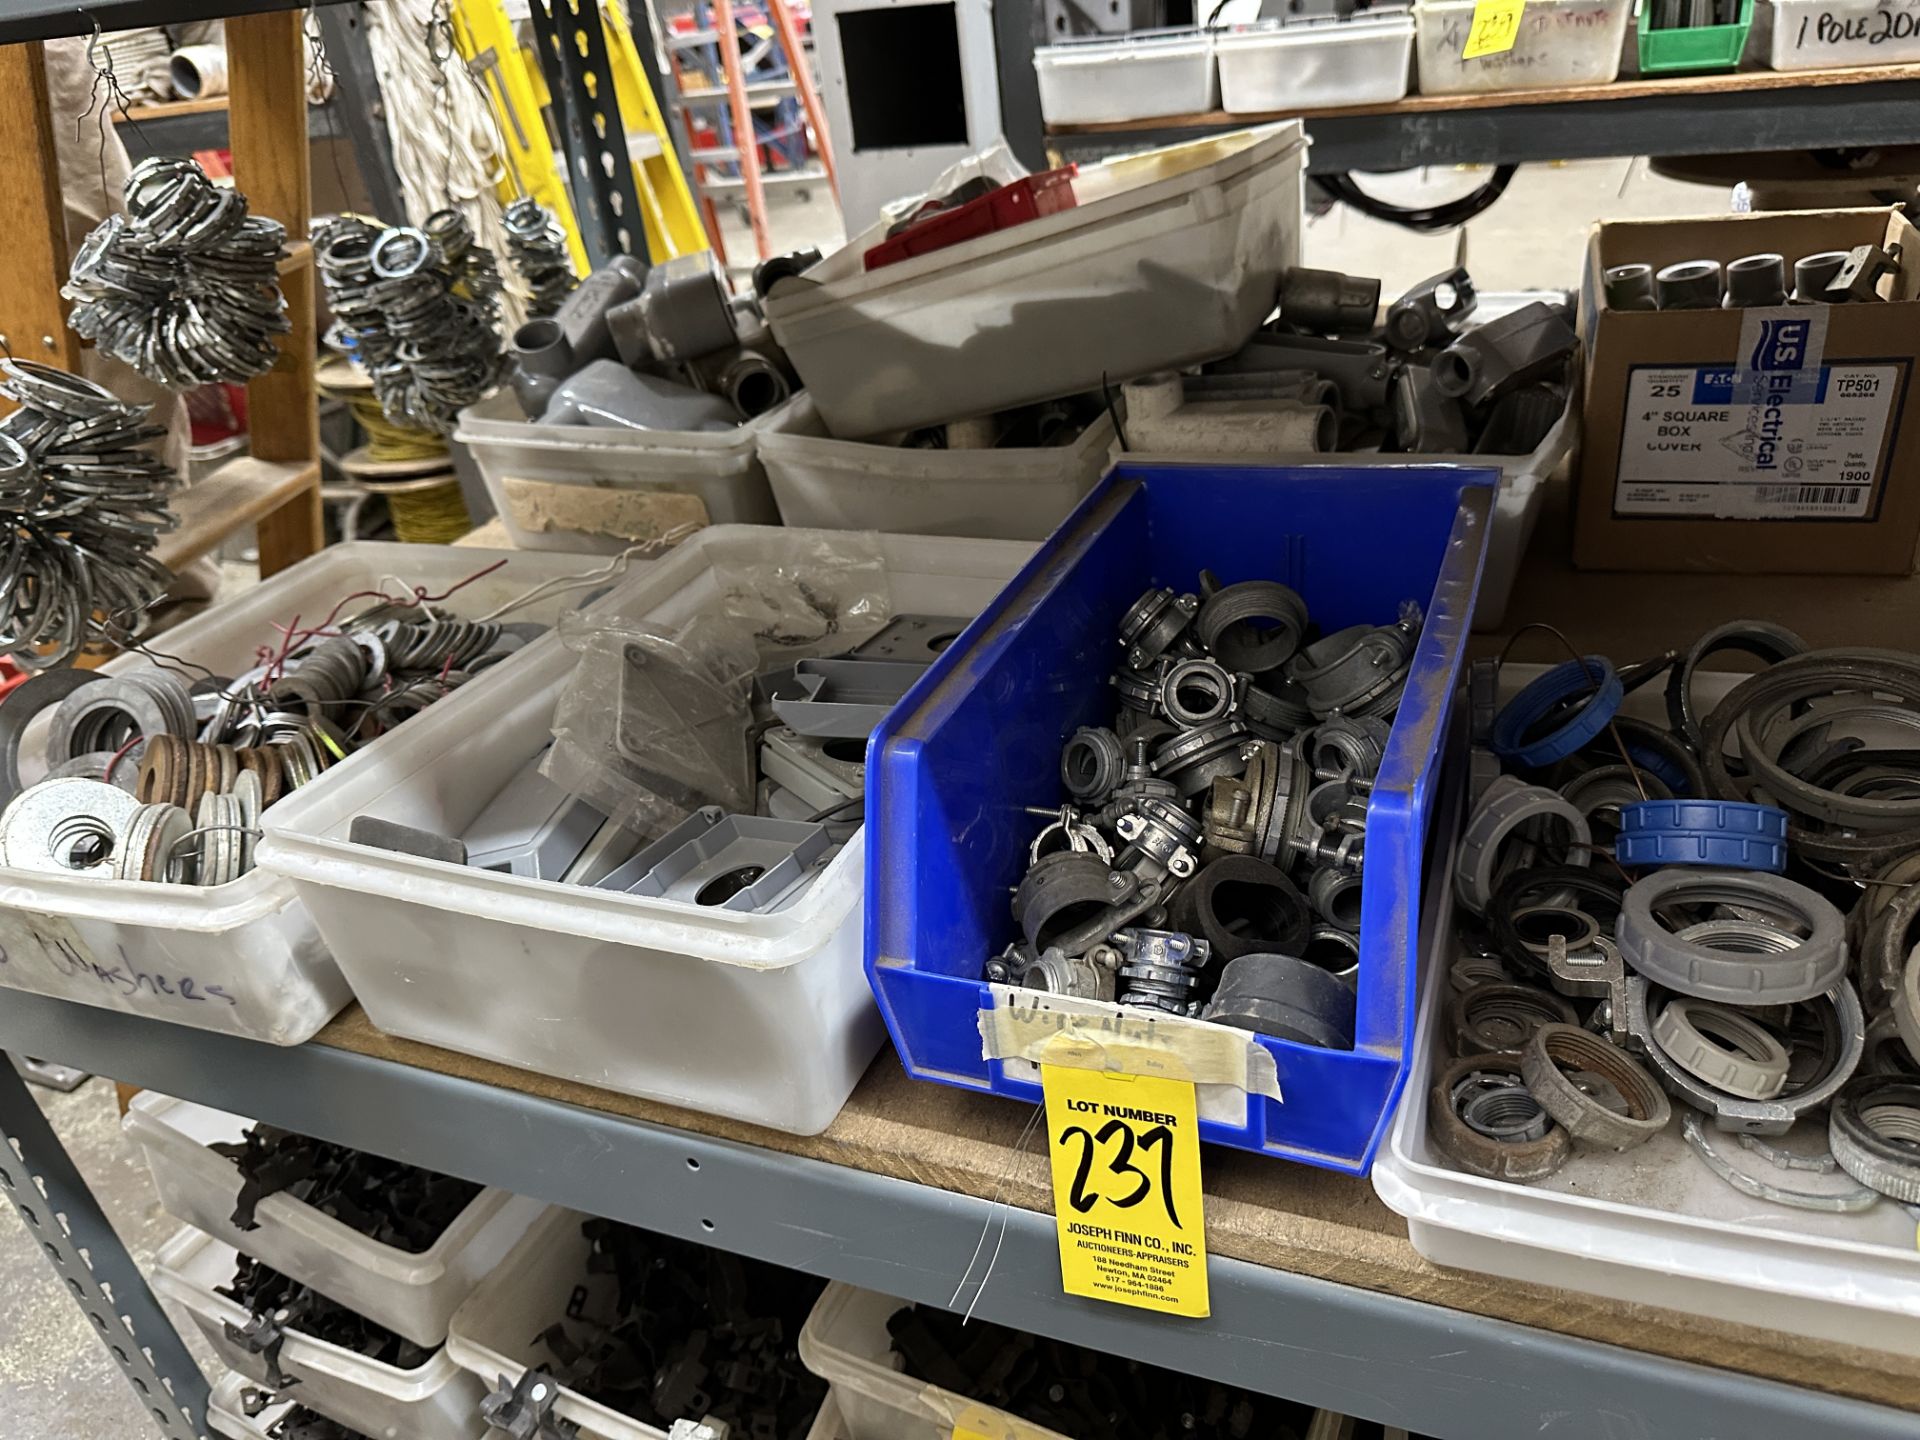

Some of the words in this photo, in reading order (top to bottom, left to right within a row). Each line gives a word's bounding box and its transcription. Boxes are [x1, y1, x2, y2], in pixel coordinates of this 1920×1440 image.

[1817, 12, 1868, 43] POLE
[1773, 324, 1801, 366] U.S.
[1650, 385, 1681, 398] 25
[1837, 379, 1880, 392] TP501
[1642, 411, 1659, 421] 4"
[1662, 411, 1729, 422] SQUARE
[1755, 374, 1793, 470] Electrical
[1657, 426, 1691, 437] BOX
[1646, 442, 1702, 452] COVER
[1839, 471, 1871, 481] 1900
[1067, 1099, 1099, 1114] LOT
[1103, 1104, 1177, 1127] NUMBER
[1059, 1119, 1183, 1230] 237
[1067, 1222, 1112, 1240] JOSEPH
[1114, 1230, 1142, 1246] FINN
[1144, 1236, 1169, 1253] CO.,
[1172, 1241, 1197, 1257] INC.
[1077, 1239, 1190, 1269] AUCTIONEERS-APPRAISERS
[1092, 1255, 1107, 1264] 188
[1109, 1258, 1148, 1272] Needham
[1150, 1266, 1176, 1277] Street
[1096, 1264, 1130, 1278] Newton,
[1132, 1271, 1146, 1281] MA
[1147, 1274, 1172, 1285] 02464
[1105, 1275, 1120, 1283] 617
[1092, 1281, 1179, 1303] www.josephfinn.com
